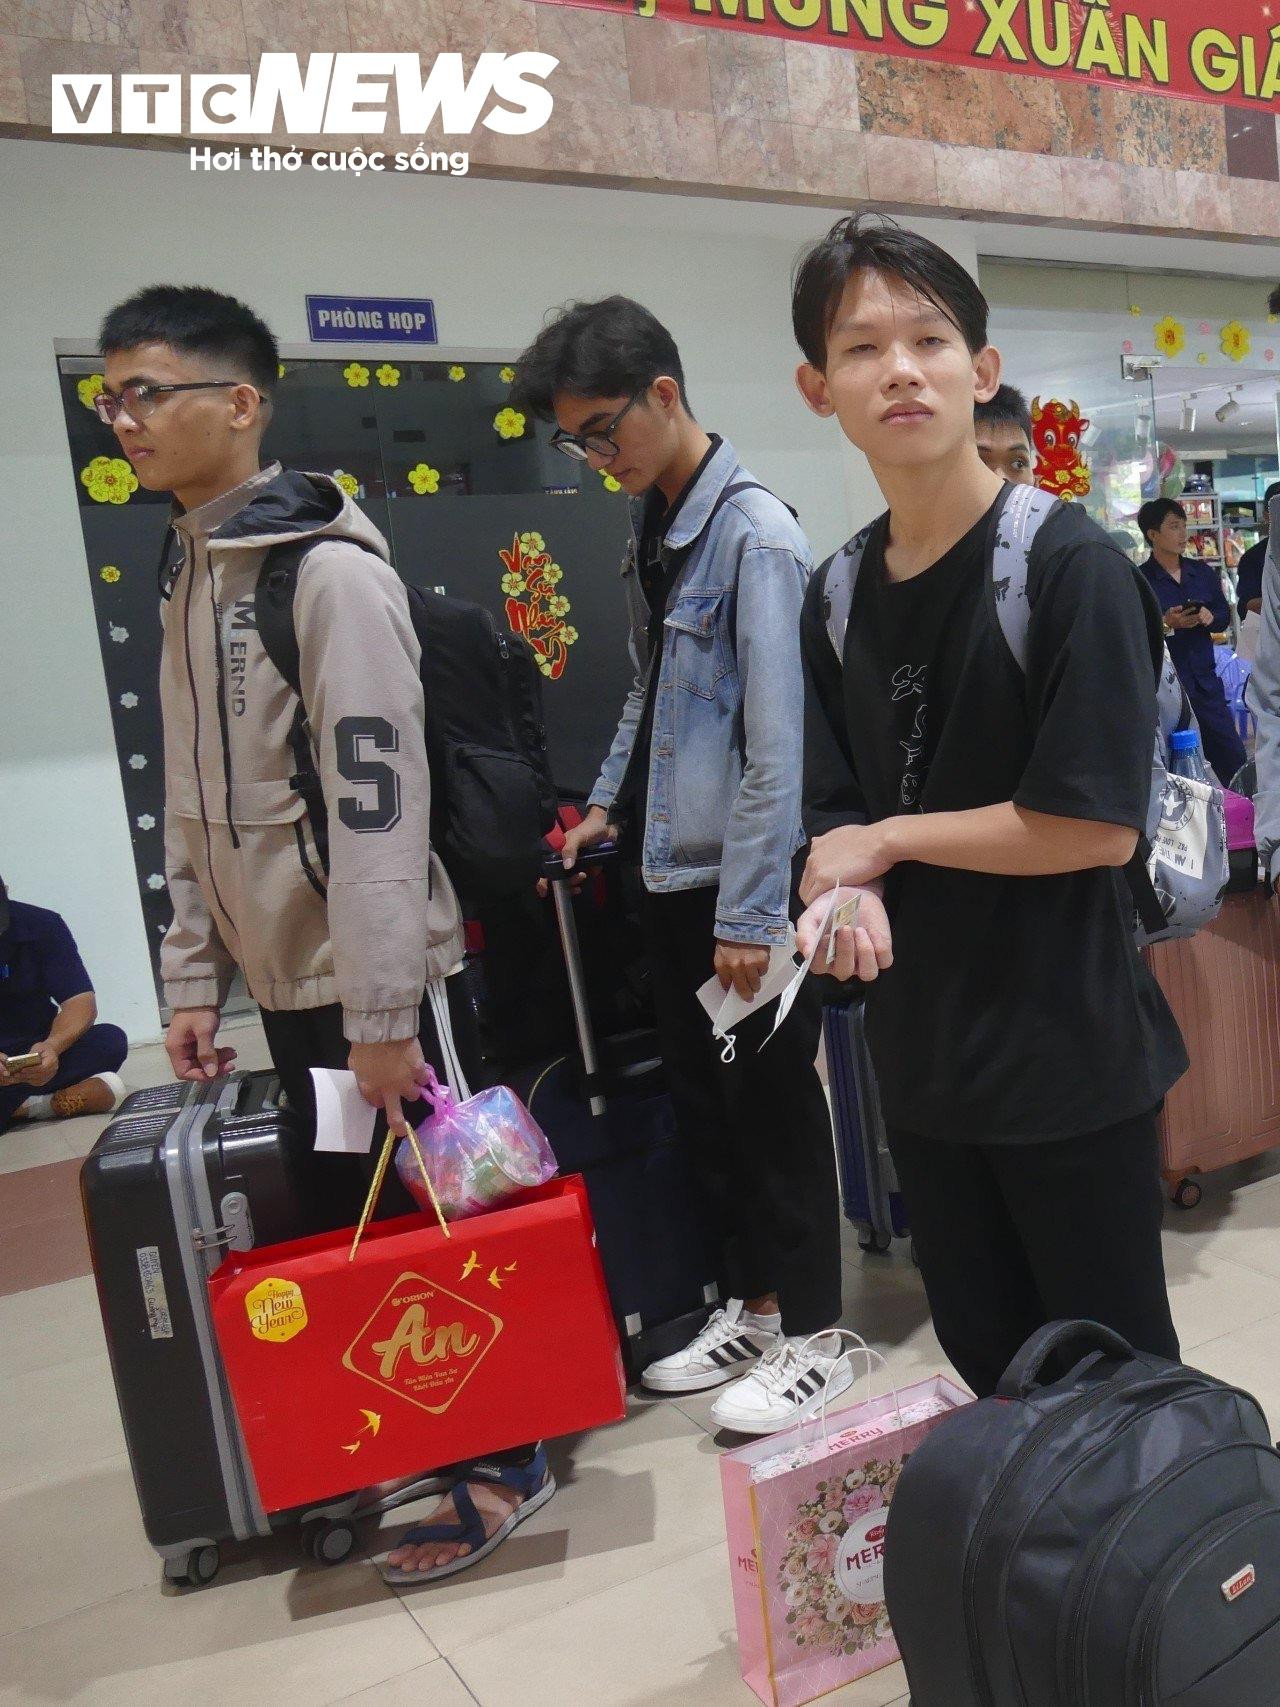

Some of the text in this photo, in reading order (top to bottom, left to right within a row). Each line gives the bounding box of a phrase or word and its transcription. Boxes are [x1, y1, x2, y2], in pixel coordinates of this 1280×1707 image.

[318, 306, 426, 334] PHÒNG HỌP
[334, 716, 402, 834] S
[402, 1291, 435, 1304] ORION
